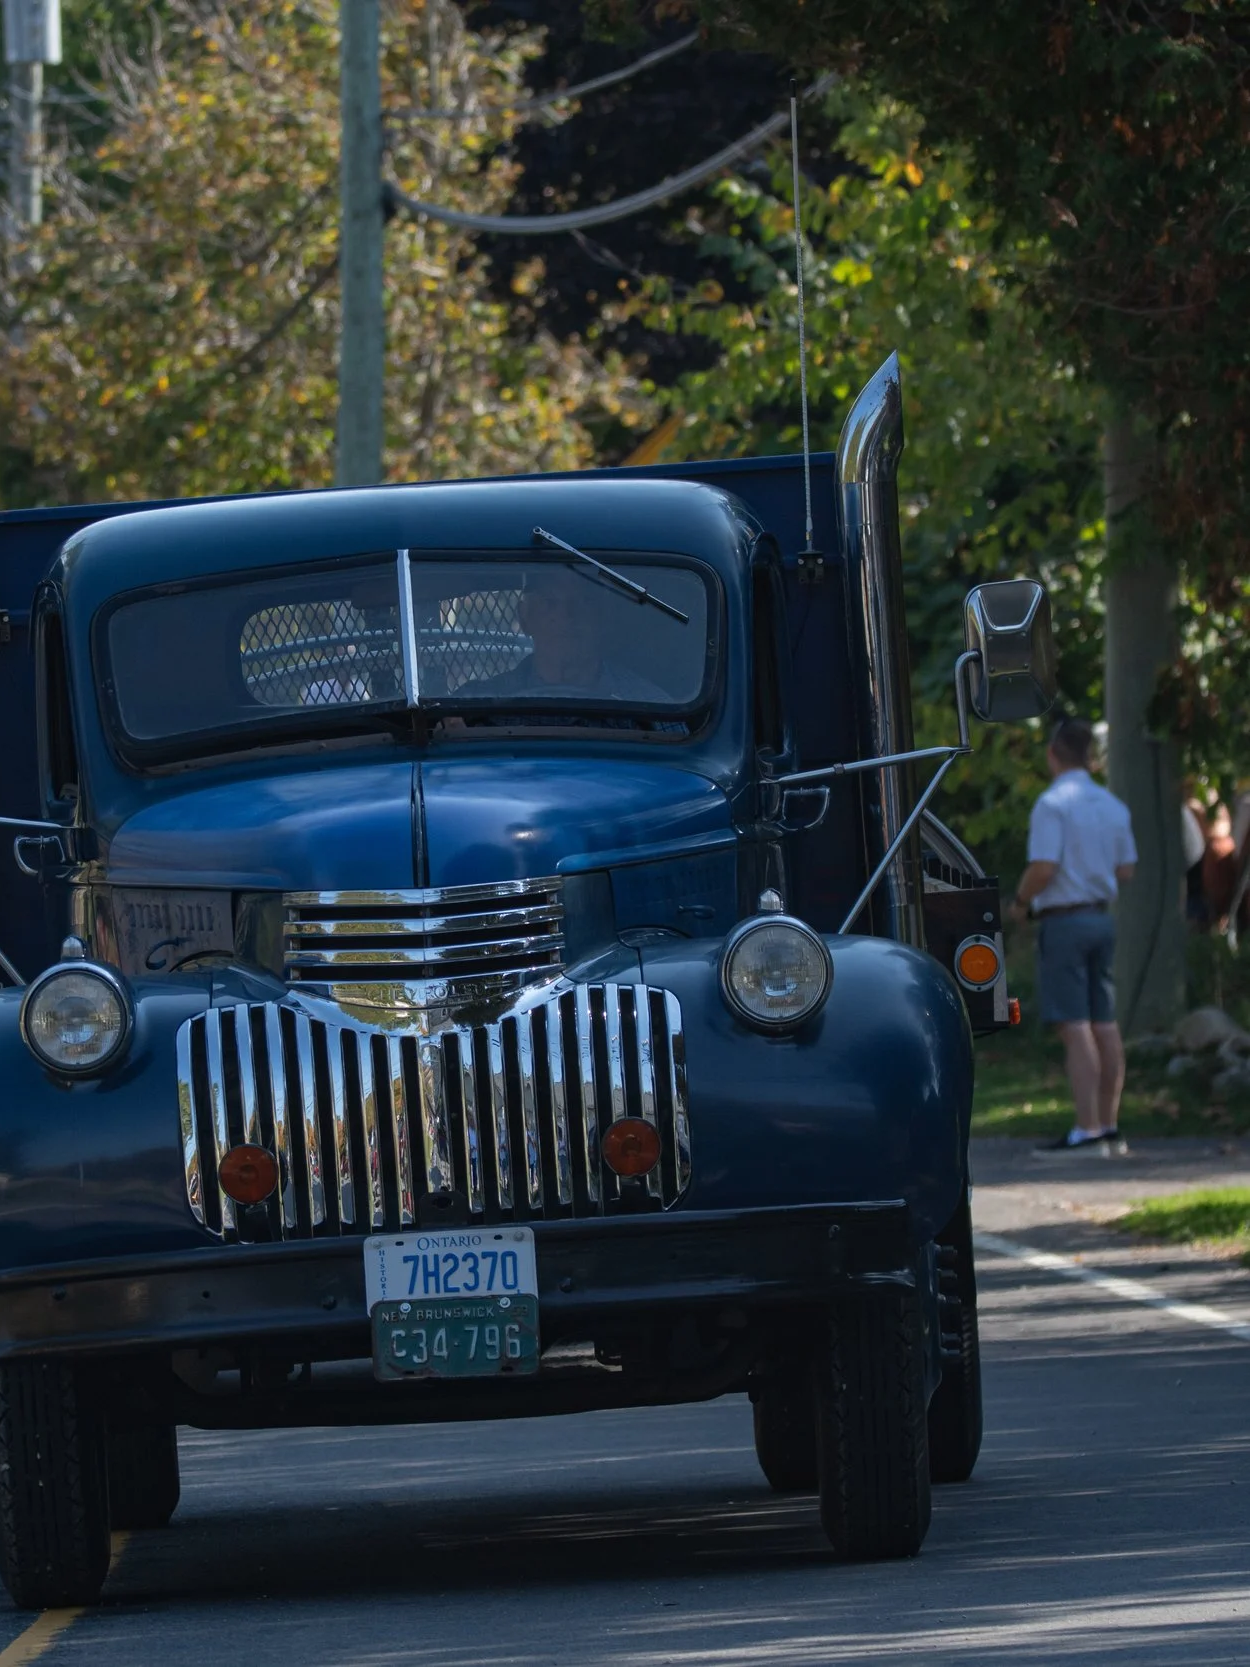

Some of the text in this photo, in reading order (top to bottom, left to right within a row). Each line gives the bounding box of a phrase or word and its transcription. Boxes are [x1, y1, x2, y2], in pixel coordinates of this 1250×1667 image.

[417, 1235, 482, 1251] ONTARIO
[403, 1250, 518, 1295] 7H2370
[381, 1307, 494, 1322] NEW BRUNSWICK
